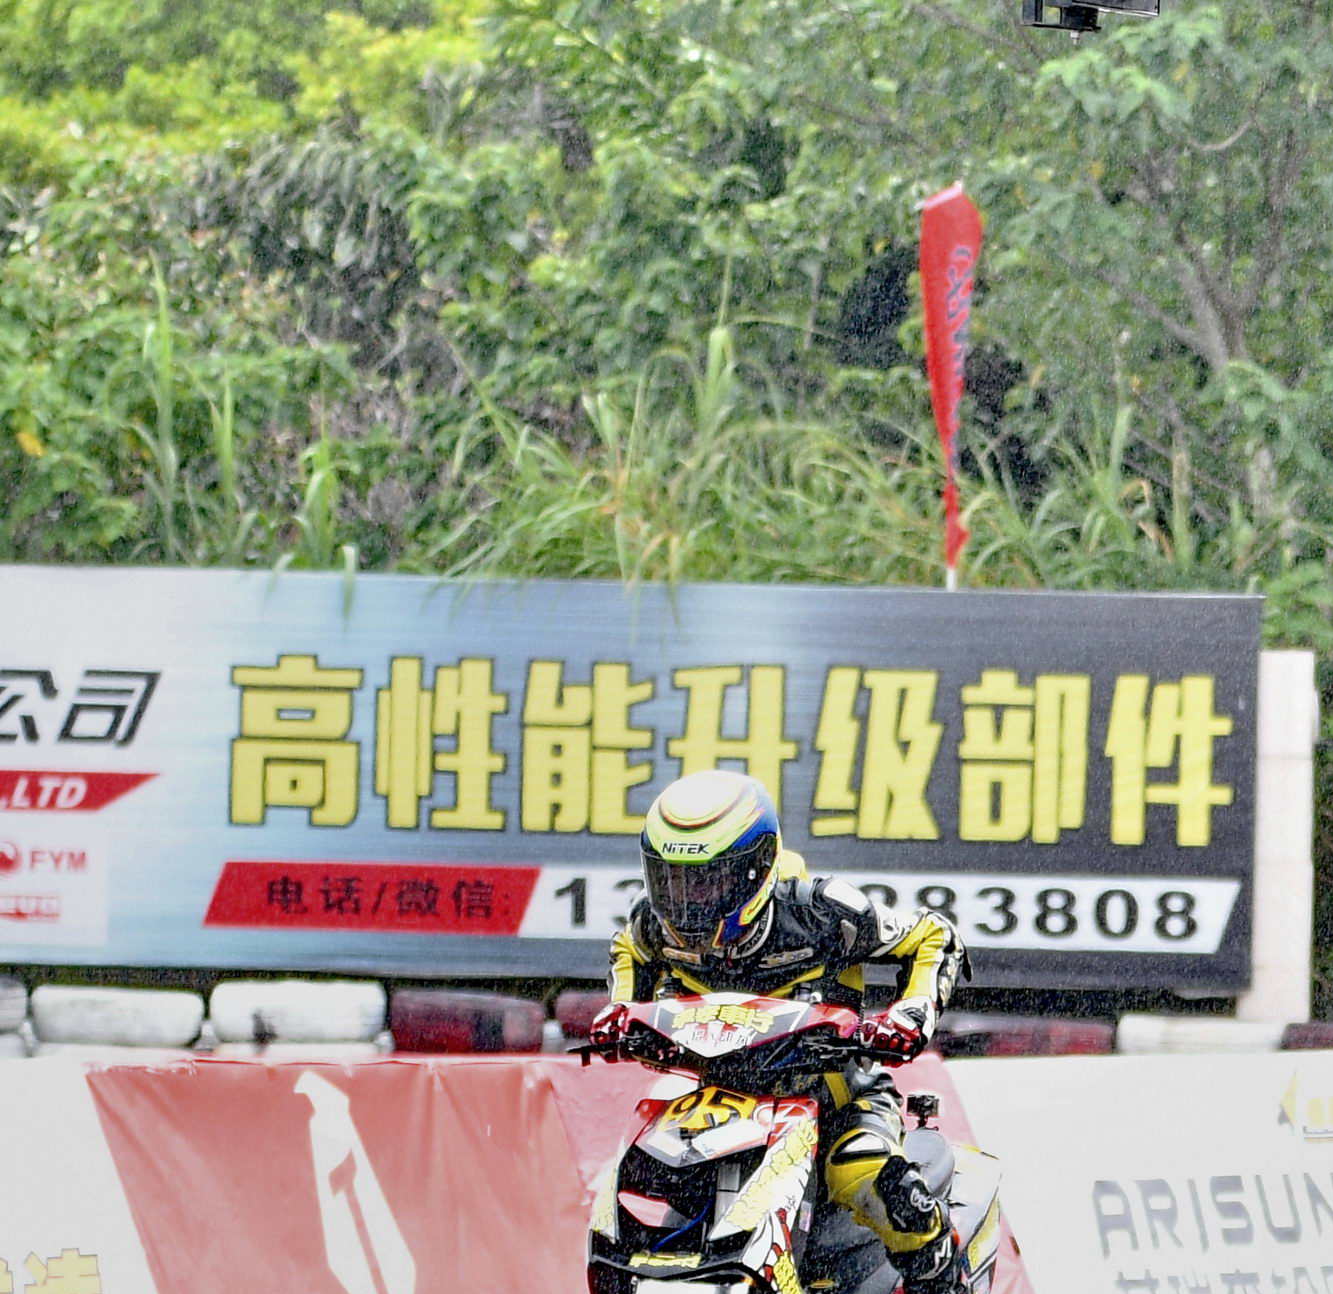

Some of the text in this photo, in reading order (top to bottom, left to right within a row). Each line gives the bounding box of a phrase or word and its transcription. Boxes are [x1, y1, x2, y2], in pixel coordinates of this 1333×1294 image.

[230, 653, 1235, 847] 高性能升级部件
[30, 849, 88, 873] FYM
